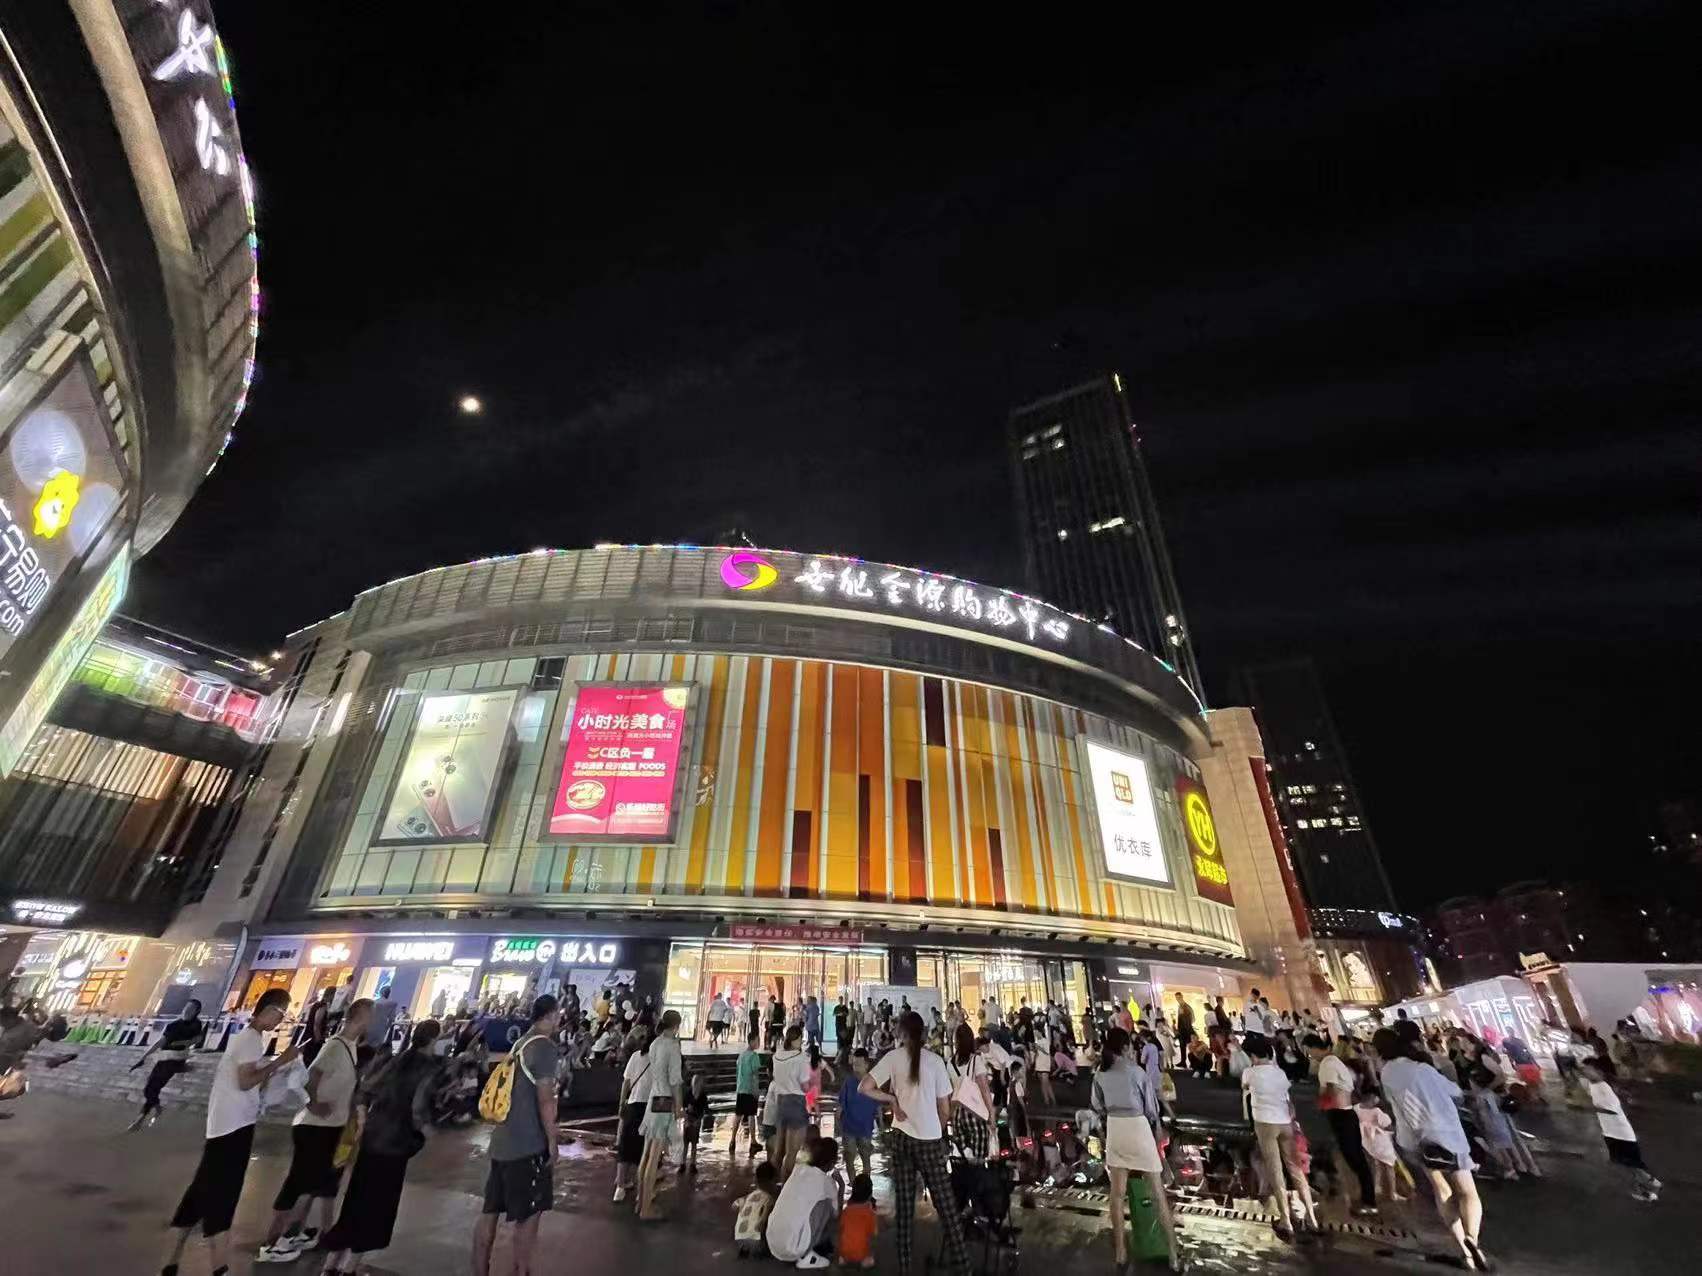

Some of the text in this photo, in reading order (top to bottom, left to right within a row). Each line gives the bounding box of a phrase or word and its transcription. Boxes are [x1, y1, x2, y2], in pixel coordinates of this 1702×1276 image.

[0, 498, 50, 614] 宁易购
[1113, 833, 1152, 857] 优衣库
[561, 941, 617, 963] 出入口
